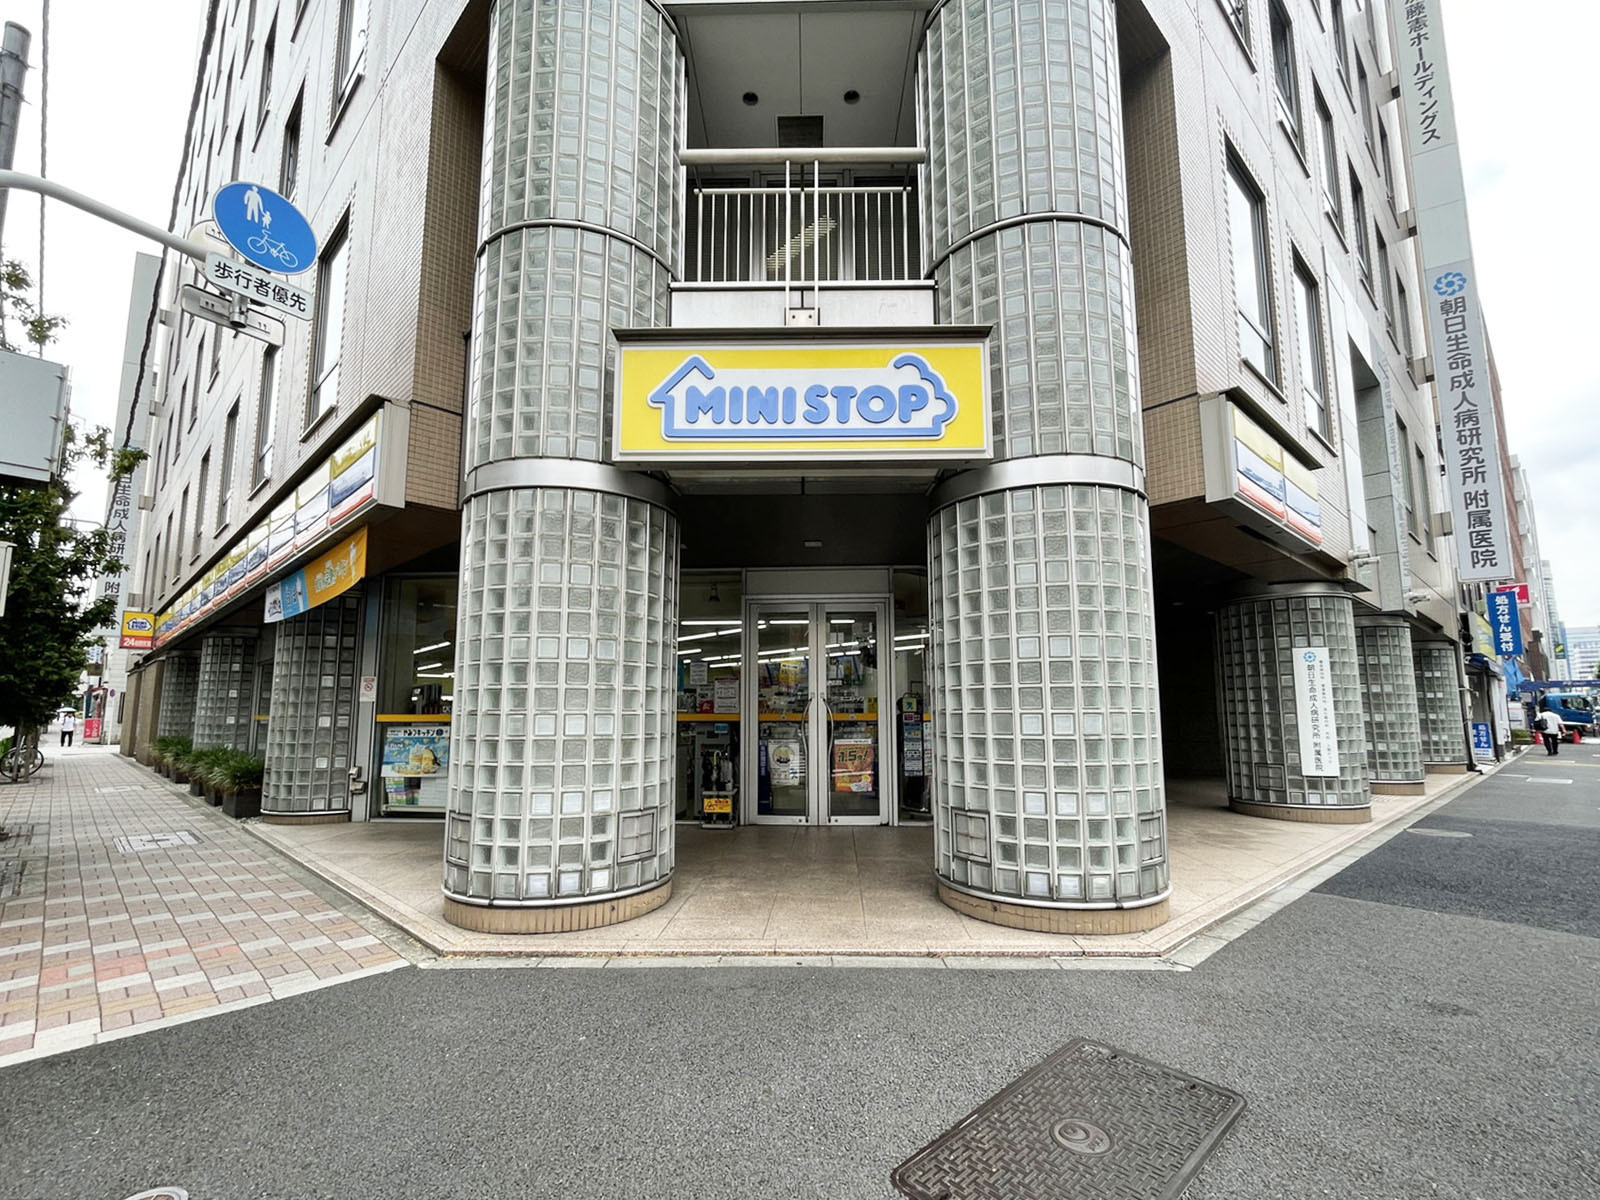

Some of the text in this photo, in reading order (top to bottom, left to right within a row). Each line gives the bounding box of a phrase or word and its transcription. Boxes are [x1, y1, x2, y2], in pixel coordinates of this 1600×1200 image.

[214, 261, 307, 312] 歩行者優先
[685, 385, 928, 424] MINISTOP
[1440, 296, 1498, 569] 朝日生命成人病研究所 附属医院
[1495, 595, 1514, 652] 処方せん受付
